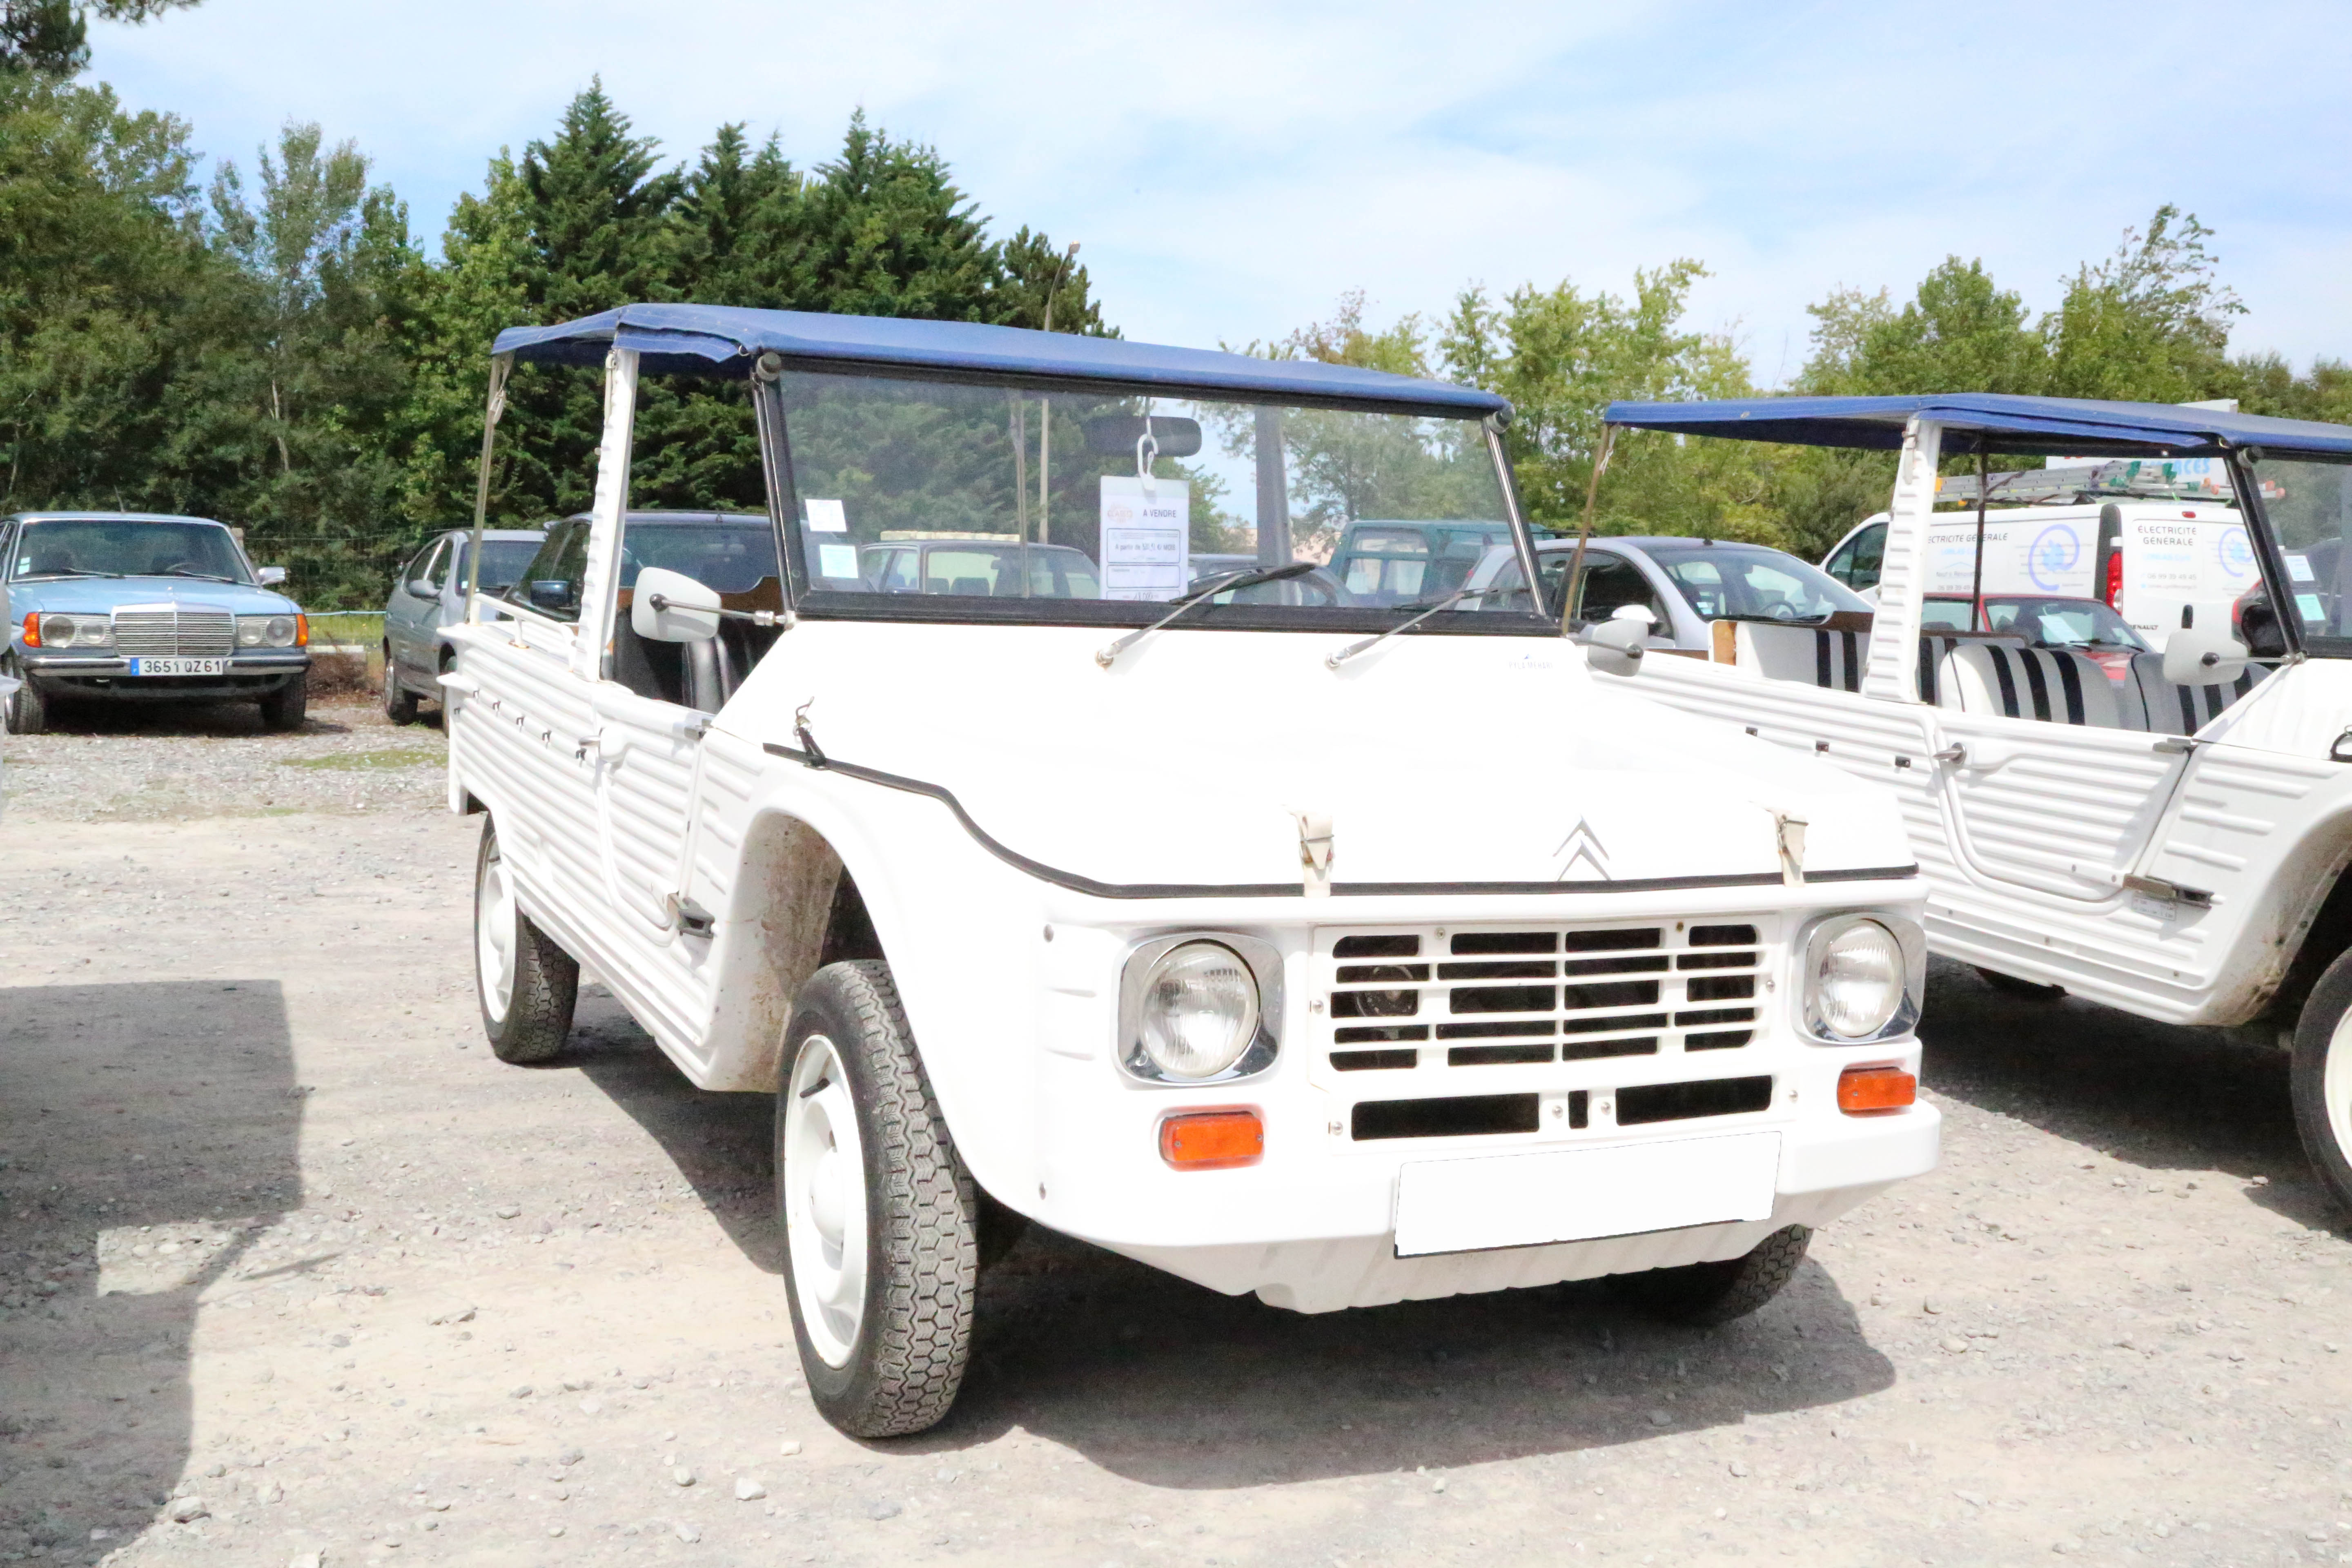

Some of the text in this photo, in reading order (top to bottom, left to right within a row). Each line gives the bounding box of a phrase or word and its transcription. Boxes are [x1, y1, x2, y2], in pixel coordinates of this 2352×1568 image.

[1150, 509, 1176, 517] VENDRE
[2138, 525, 2197, 535] ÉLECTRICITÉ
[1928, 534, 1964, 543] ECTRICITÉ
[144, 660, 179, 673] 3651
[1509, 661, 1553, 670] PYLA MEHARI
